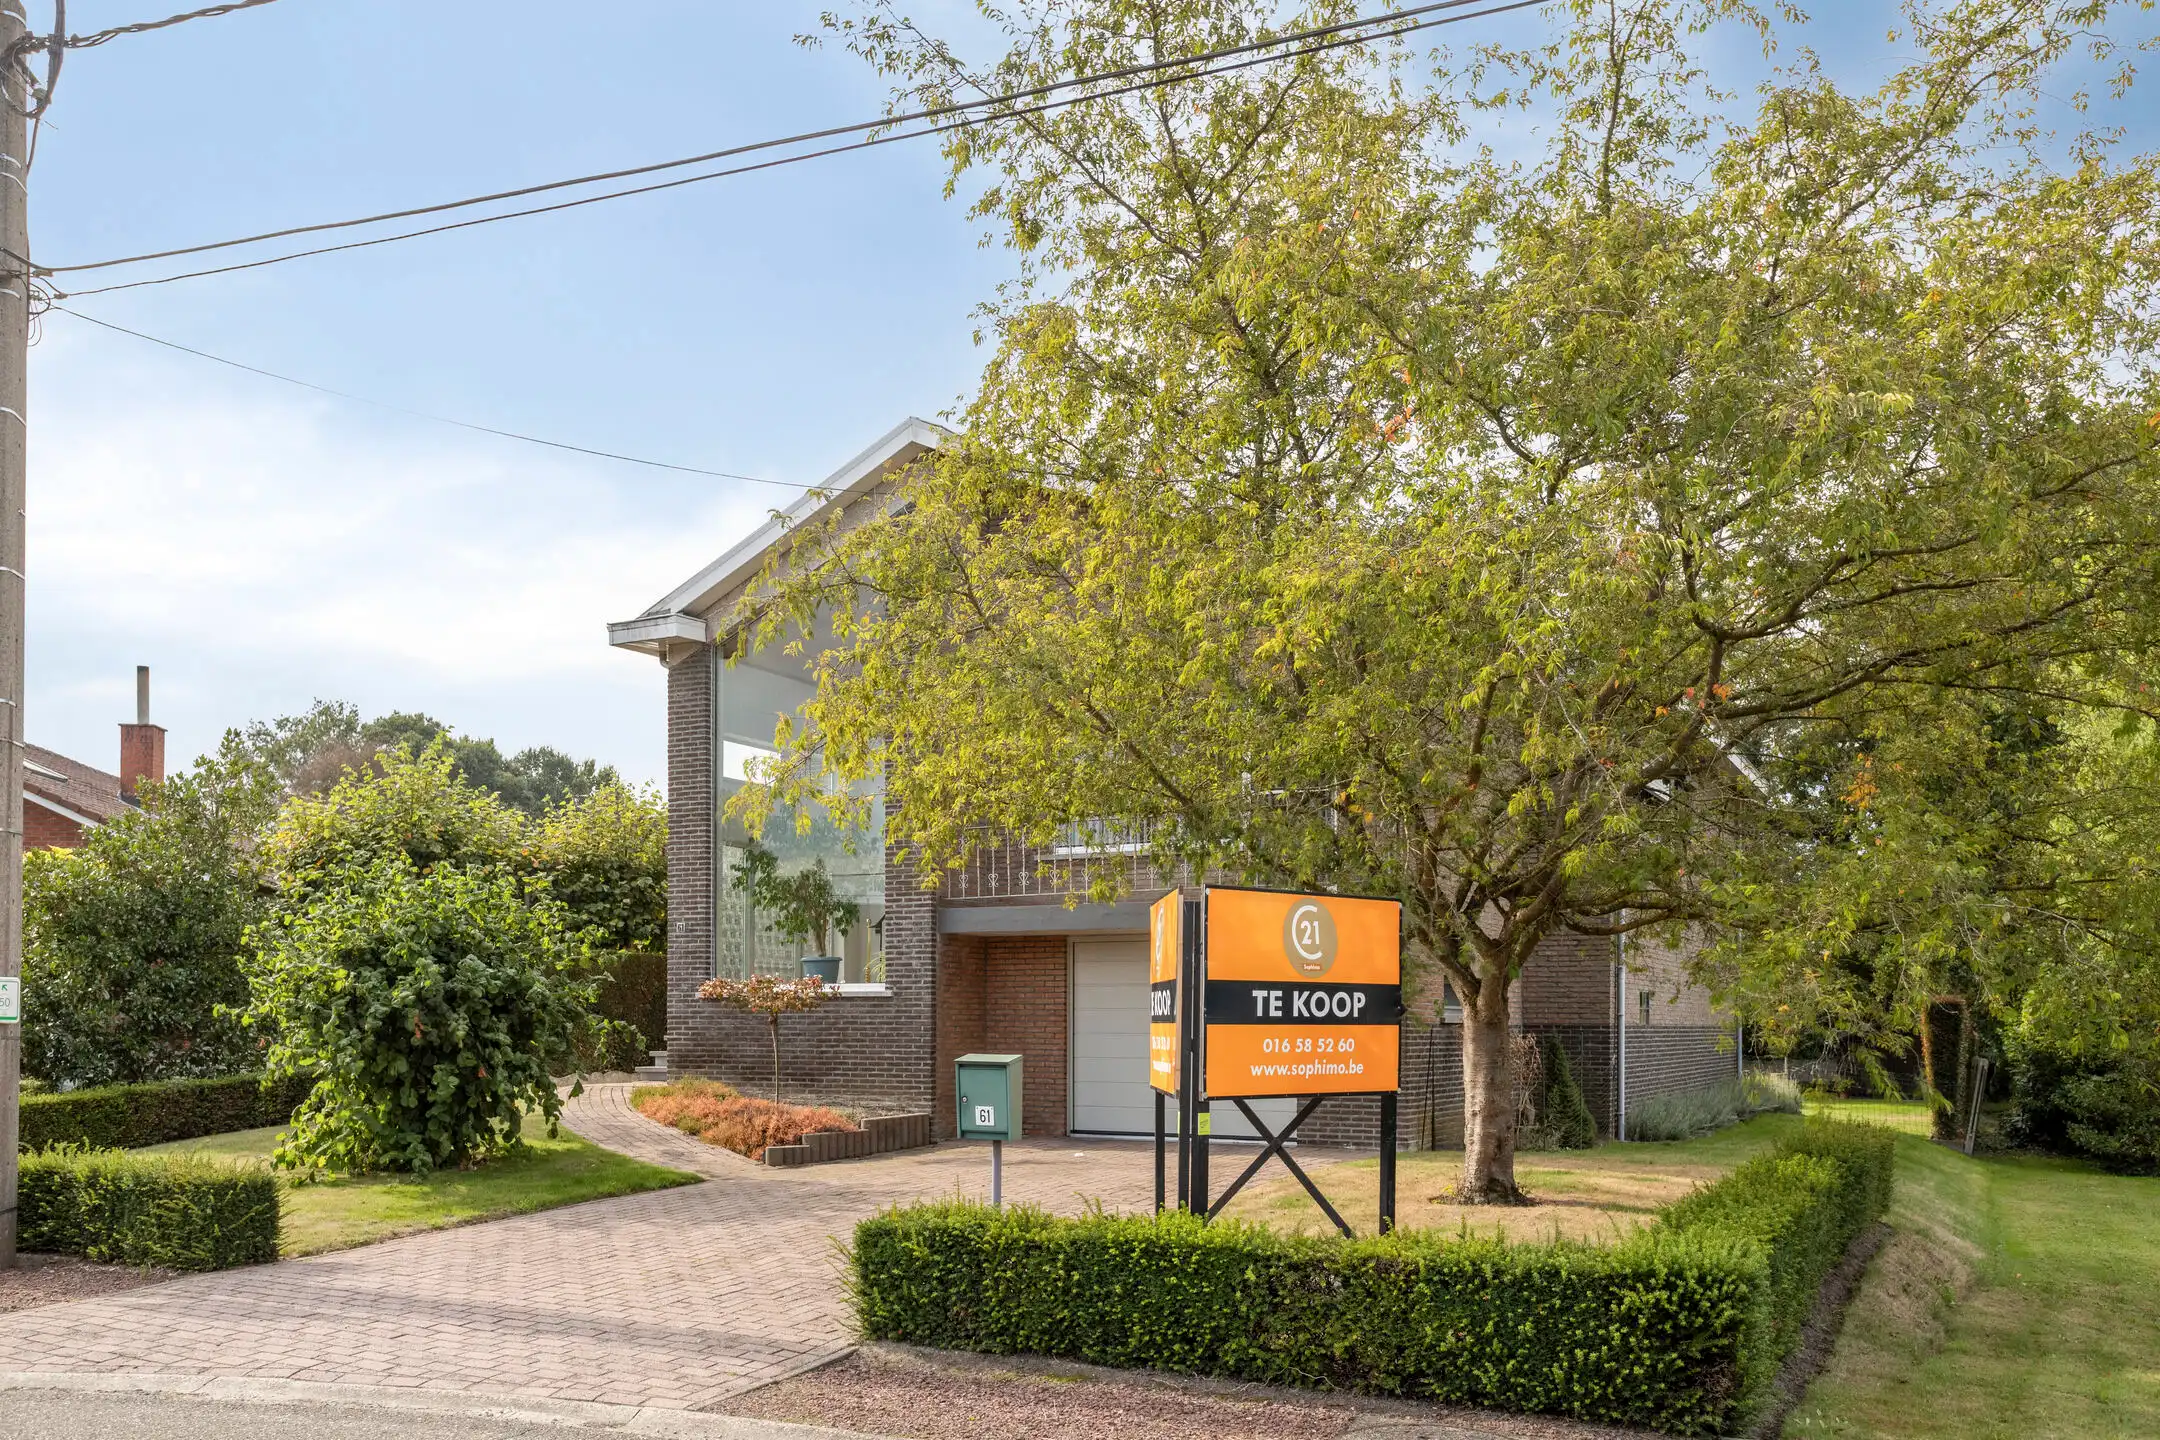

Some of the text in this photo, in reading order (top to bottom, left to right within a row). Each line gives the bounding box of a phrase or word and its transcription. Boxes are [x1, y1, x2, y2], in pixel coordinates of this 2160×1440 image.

[1252, 990, 1366, 1018] TE KOOP
[1263, 1038, 1355, 1053] 016 58 52 60
[1250, 1059, 1364, 1079] www.sophimo.be
[979, 1109, 991, 1123] 61
